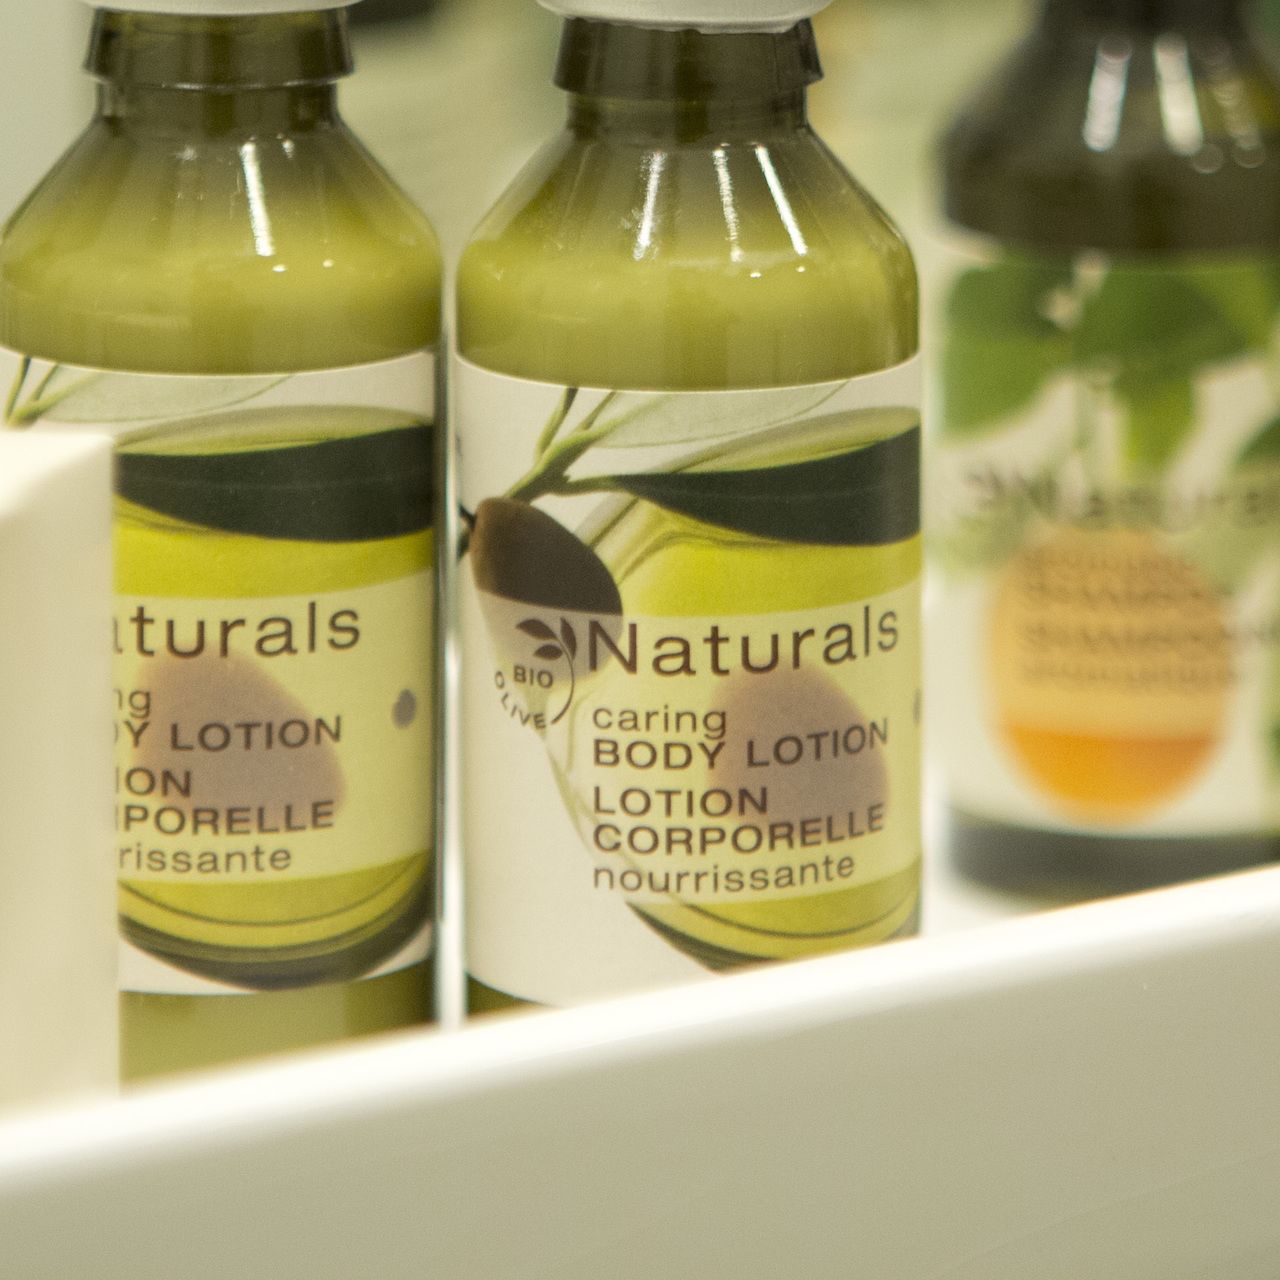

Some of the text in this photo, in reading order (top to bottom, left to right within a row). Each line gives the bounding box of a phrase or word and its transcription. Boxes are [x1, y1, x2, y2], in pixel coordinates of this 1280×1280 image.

[588, 606, 897, 676] Naturals
[513, 665, 554, 689] BIO
[494, 669, 547, 730] OLIVE
[171, 715, 341, 751] LOTION
[592, 705, 726, 740] caring
[593, 718, 888, 769] BODY LOTION
[115, 801, 335, 836] PORELLE
[593, 785, 768, 818] LOTION
[593, 802, 884, 856] CORPORELLE
[593, 855, 854, 894] nourrissante
